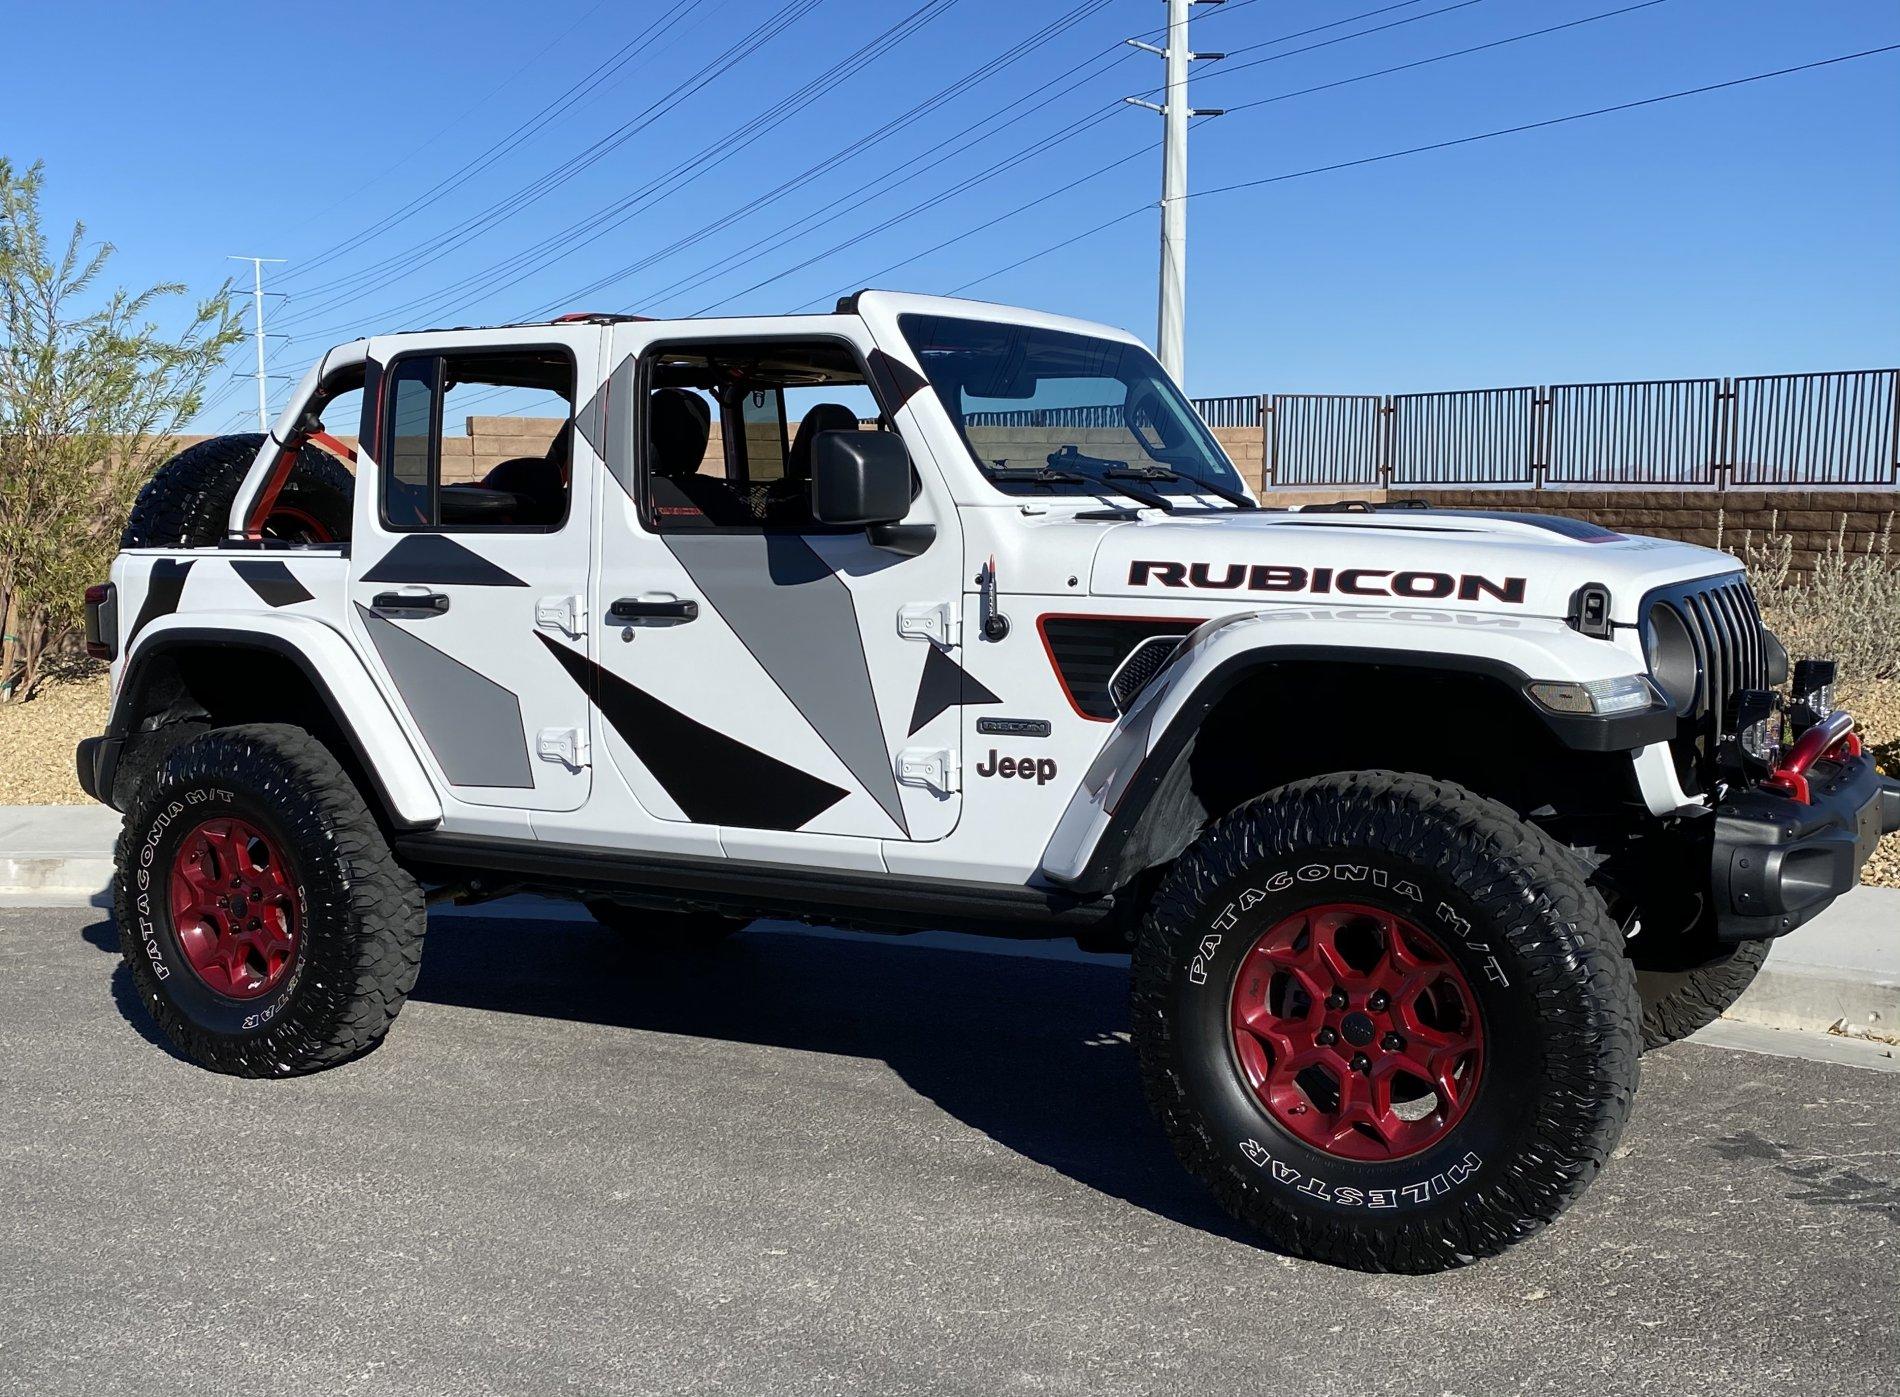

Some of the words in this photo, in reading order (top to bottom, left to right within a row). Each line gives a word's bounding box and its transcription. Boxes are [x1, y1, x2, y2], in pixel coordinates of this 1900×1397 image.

[1128, 560, 1526, 604] RUBICON
[976, 749, 1057, 786] Jeep
[137, 801, 184, 981] PATAGONIA
[1189, 864, 1423, 985] PATAGONIA
[1436, 902, 1510, 988] M/T
[1239, 1138, 1482, 1209] MILESTAR
